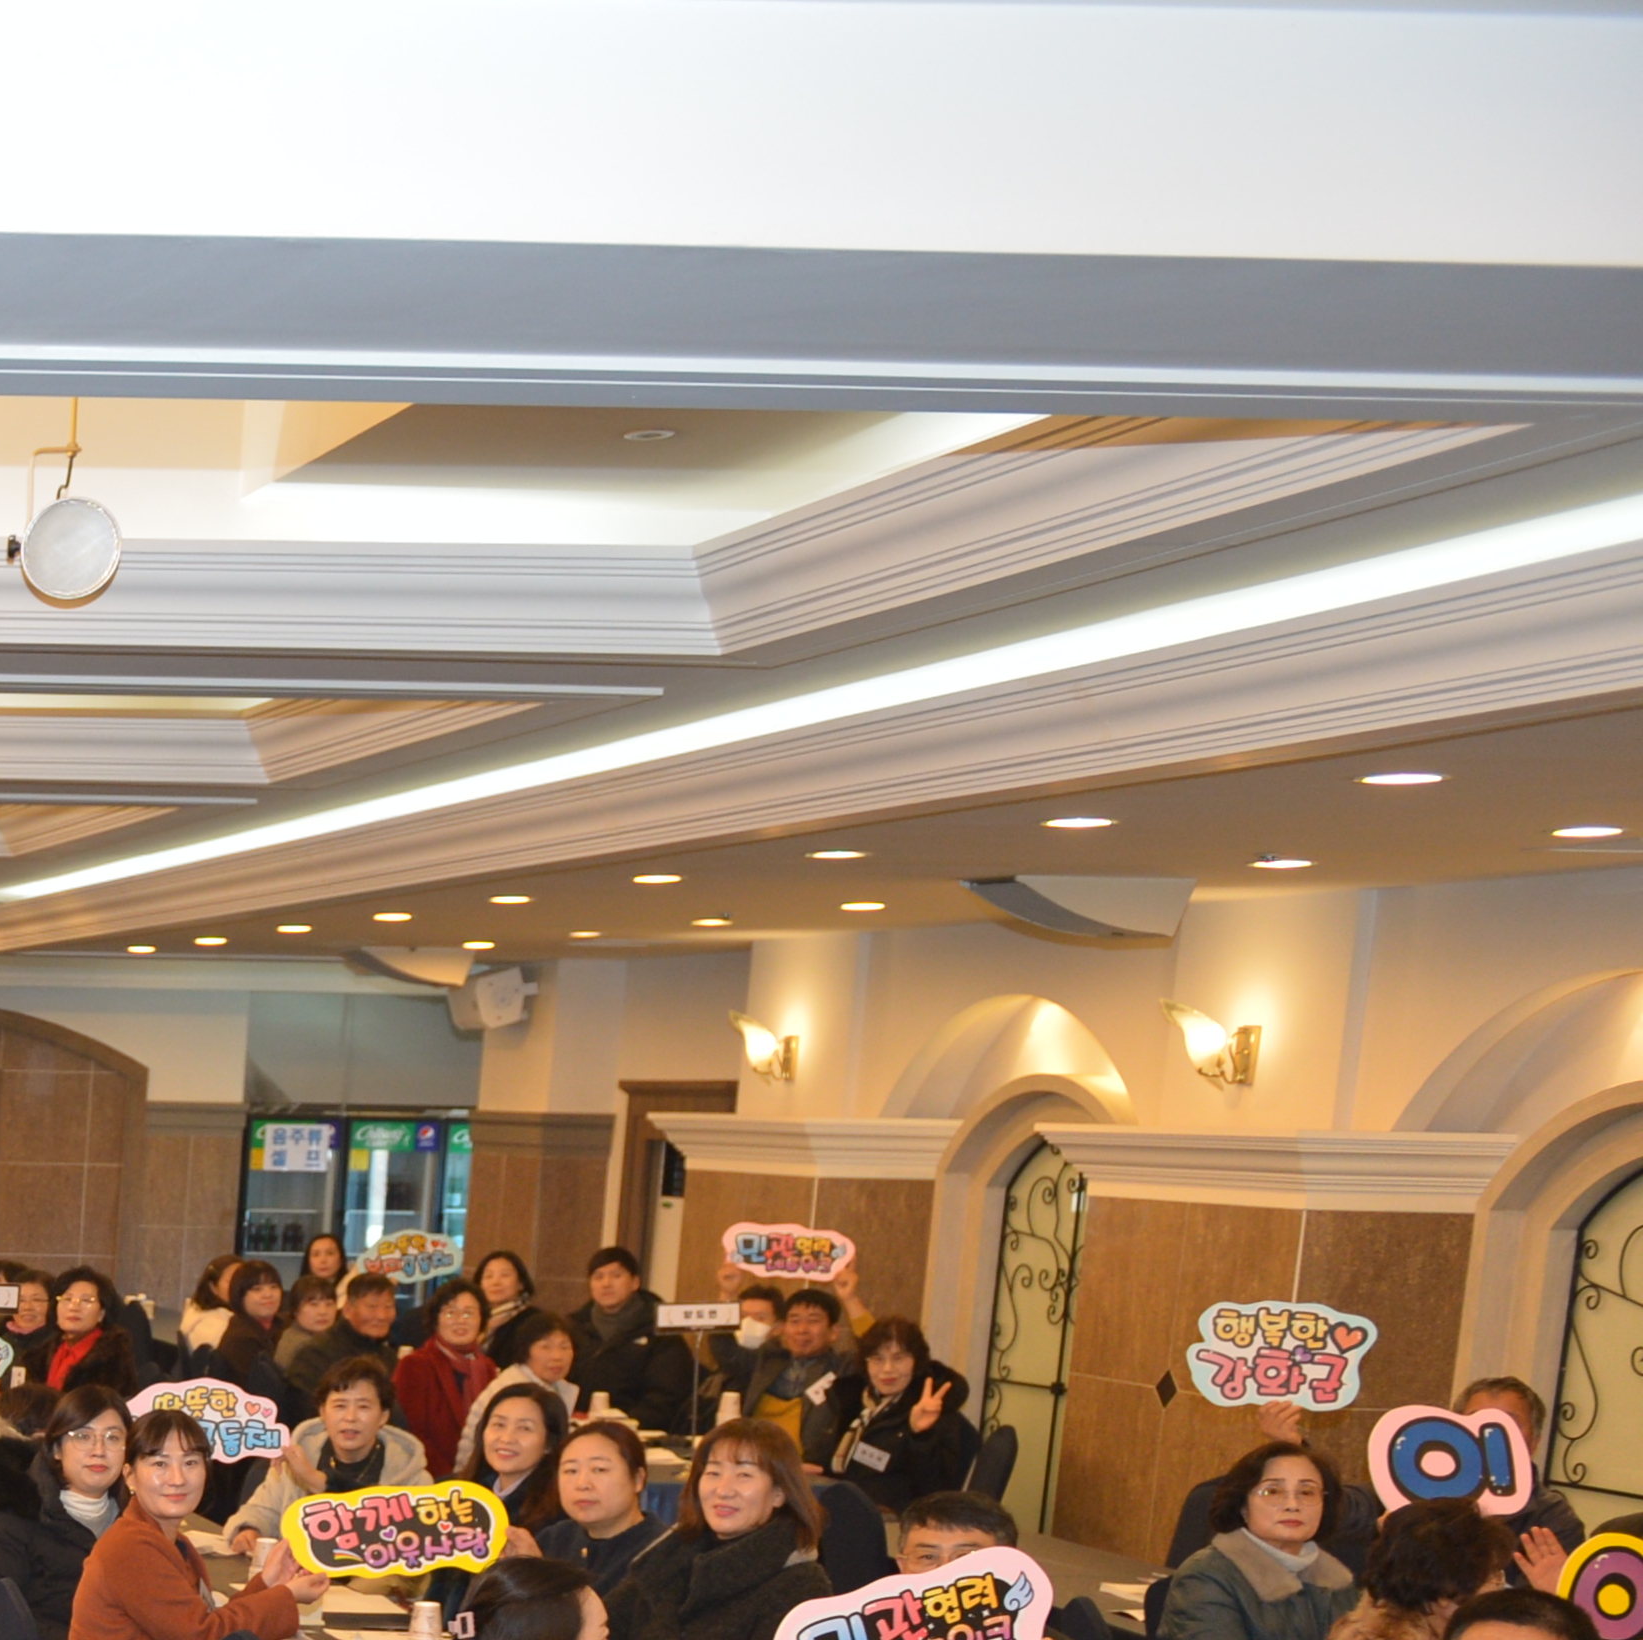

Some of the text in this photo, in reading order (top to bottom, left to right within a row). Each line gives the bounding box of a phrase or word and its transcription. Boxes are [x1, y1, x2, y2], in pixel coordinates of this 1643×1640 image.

[1213, 1306, 1330, 1350] 행복한
[1195, 1346, 1349, 1404] 강화군
[363, 1525, 491, 1568] 이웃사랑
